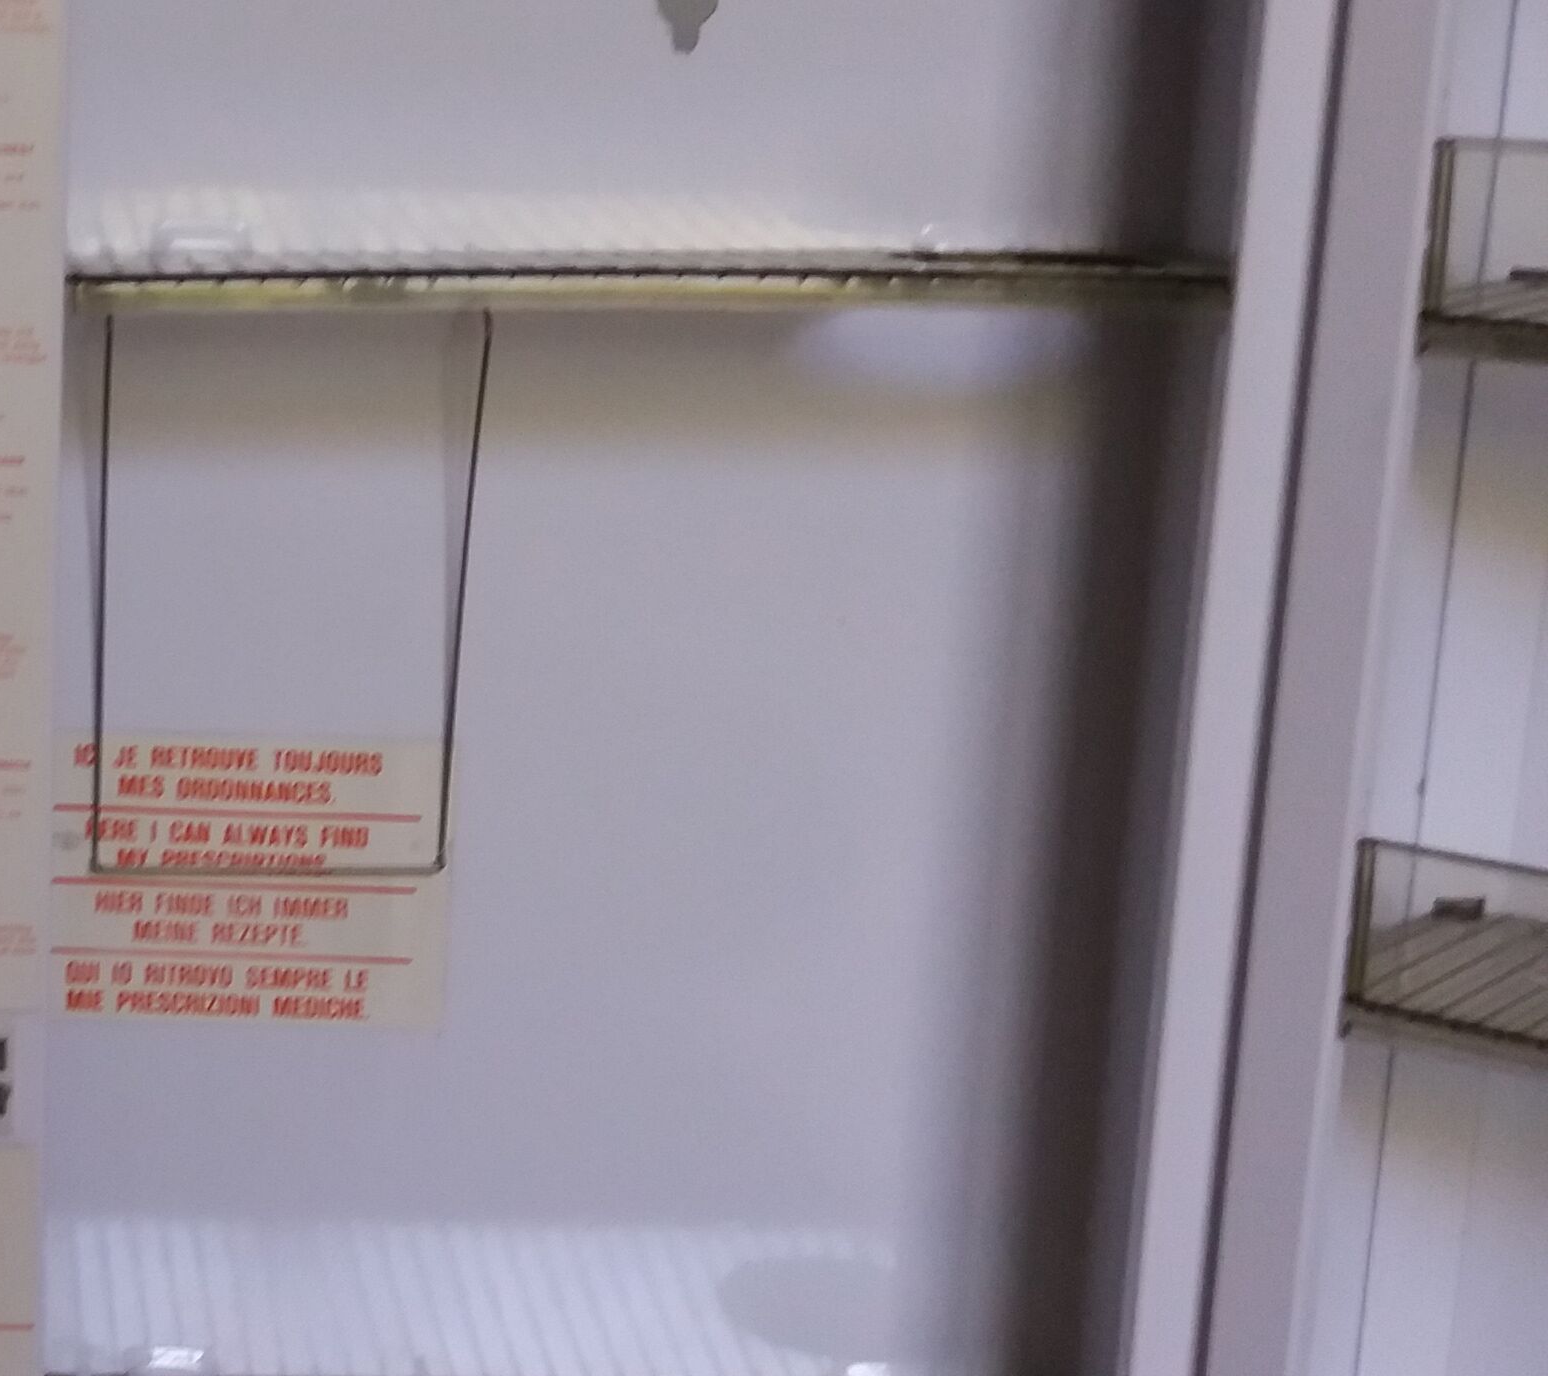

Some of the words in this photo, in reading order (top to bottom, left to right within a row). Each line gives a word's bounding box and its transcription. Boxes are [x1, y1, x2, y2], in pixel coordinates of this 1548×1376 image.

[73, 743, 102, 768] IC
[112, 745, 138, 769] JE
[150, 745, 259, 771] RETROUVE
[273, 748, 384, 776] TOUJOURS
[117, 773, 164, 799] MES
[149, 820, 157, 843] I
[169, 820, 211, 844] CAN
[222, 822, 308, 848] ALWAYS
[319, 826, 370, 849] FIND
[116, 847, 149, 870] MY
[94, 891, 144, 915] HIER
[154, 893, 214, 917] FINDE
[226, 894, 262, 917] ICH
[272, 896, 348, 921] IMMER
[132, 920, 199, 944] MEINE
[64, 960, 100, 985] QUI
[111, 961, 133, 984] IO
[143, 962, 233, 989] RITROVO
[245, 966, 333, 993] SEMPRE
[343, 969, 369, 993] LE
[65, 988, 104, 1013] MIE
[115, 990, 261, 1018] PRESCRIZIONI
